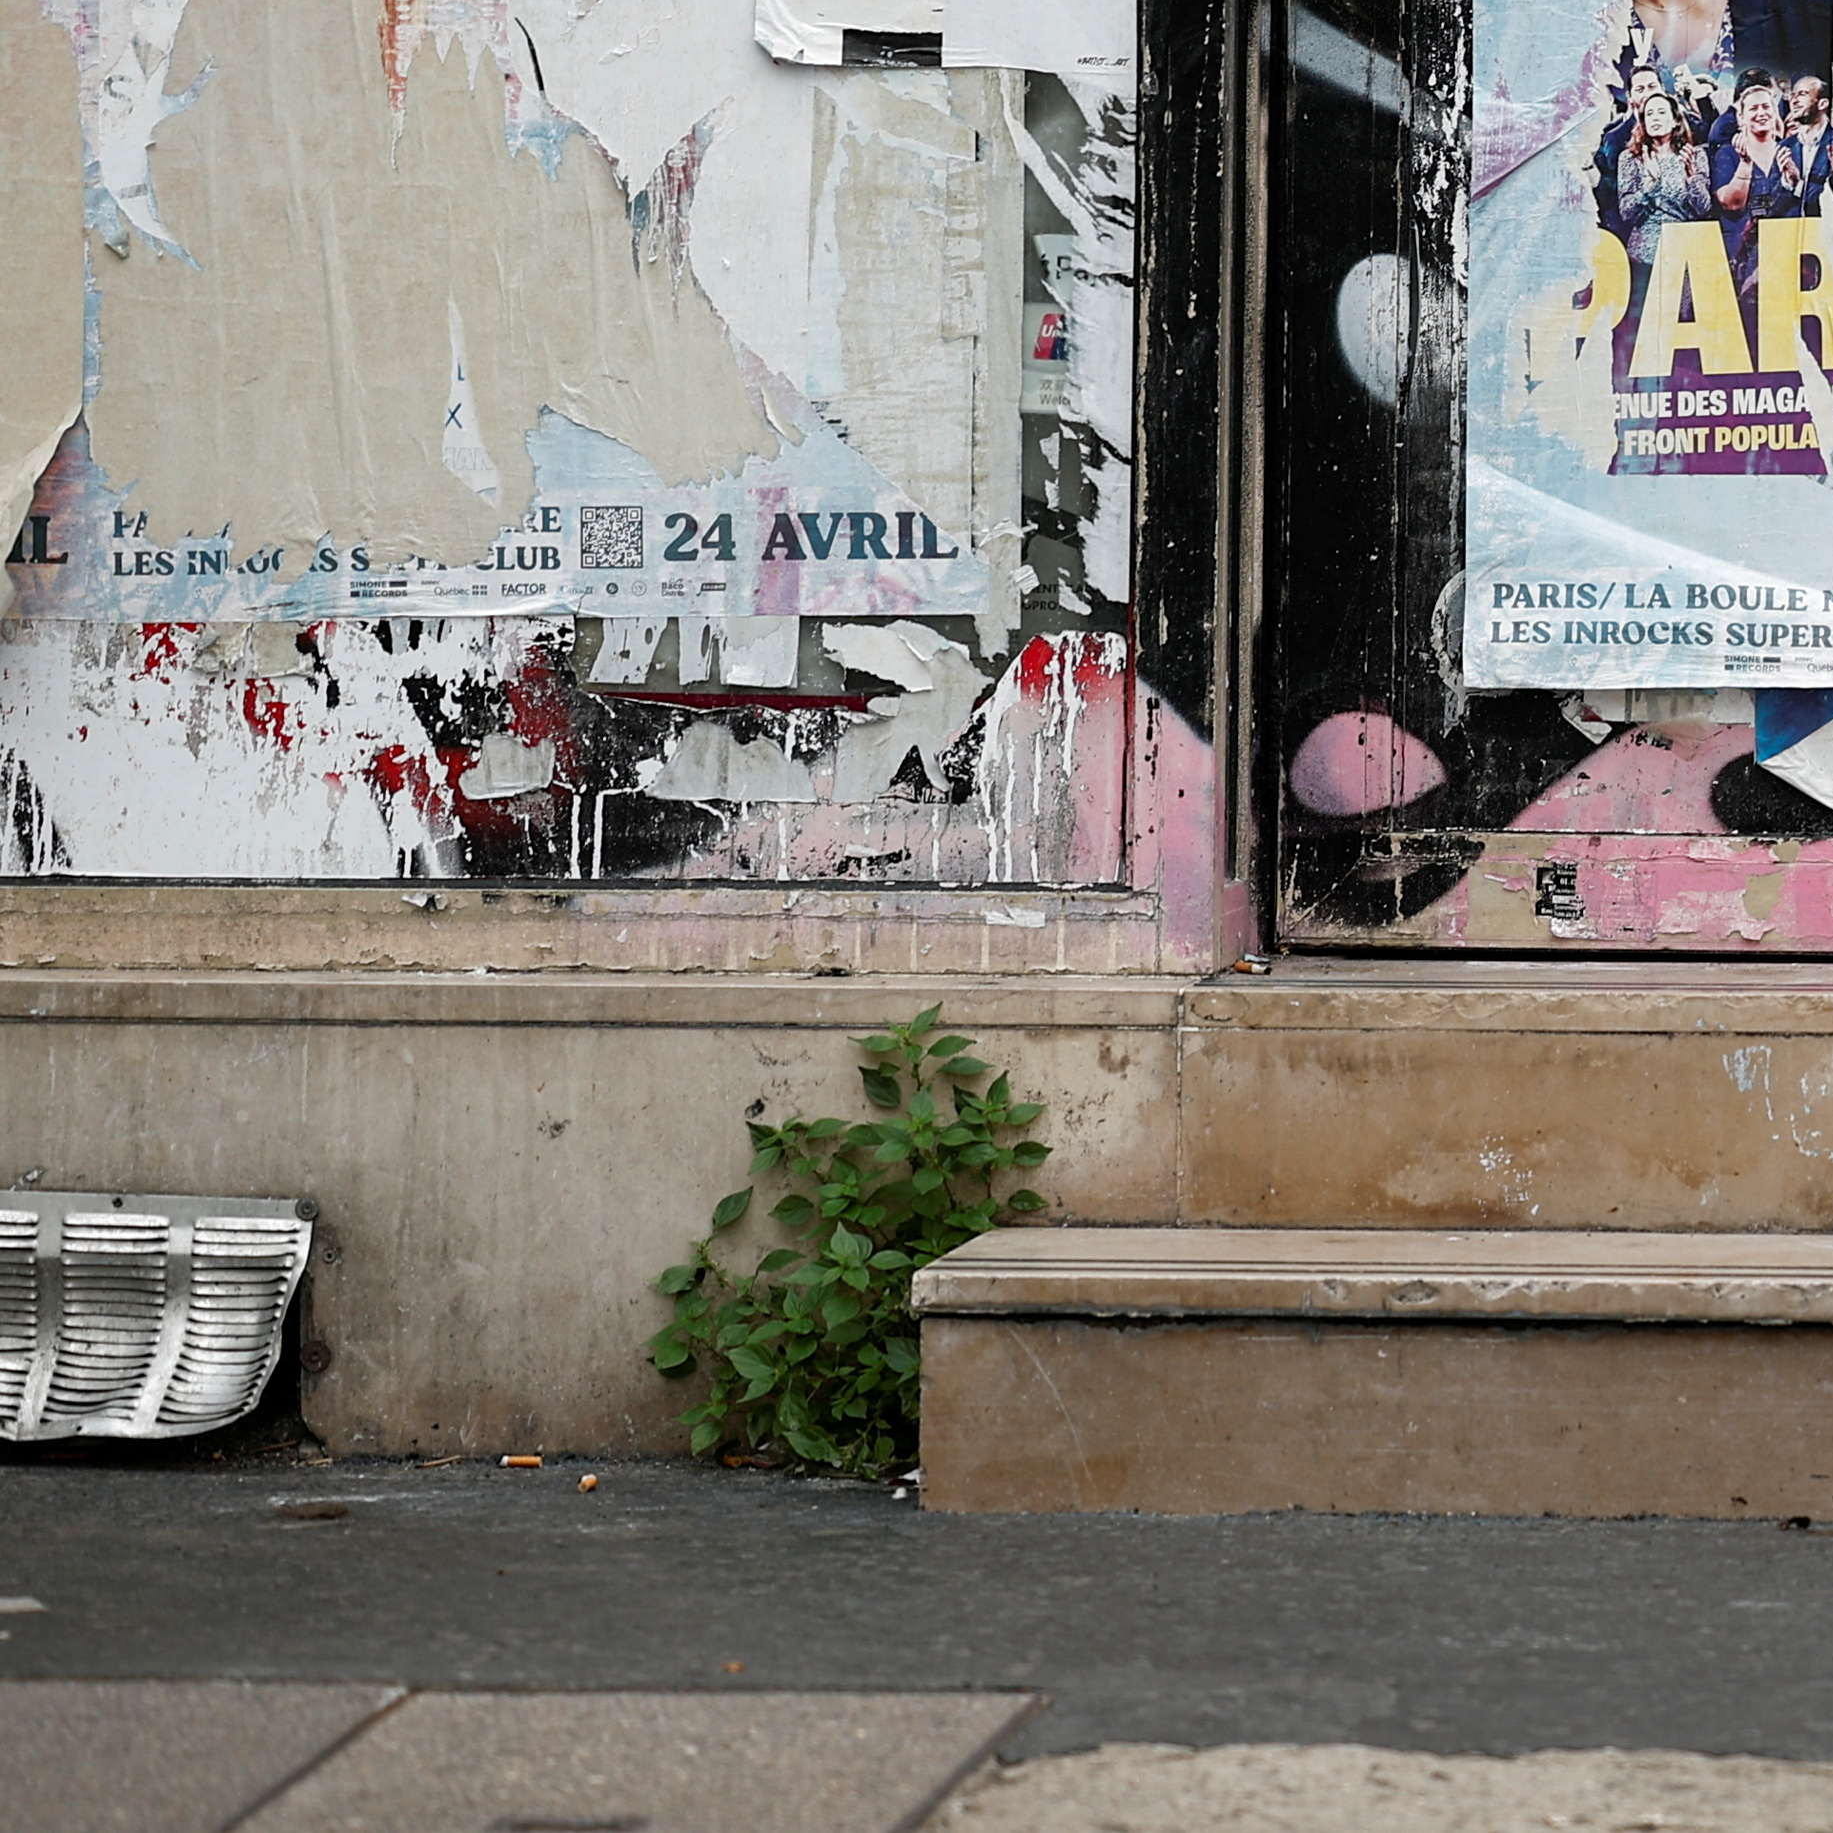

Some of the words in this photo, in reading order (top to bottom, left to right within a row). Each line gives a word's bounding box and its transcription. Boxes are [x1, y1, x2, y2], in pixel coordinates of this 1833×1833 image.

[662, 513, 736, 561] 24
[764, 512, 959, 560] AVRIL
[1625, 584, 1671, 609] LA
[1687, 586, 1808, 612] BOULE
[1490, 621, 1551, 644] LES
[1564, 621, 1713, 646] INROCKS
[1726, 623, 1833, 648] SUPER
